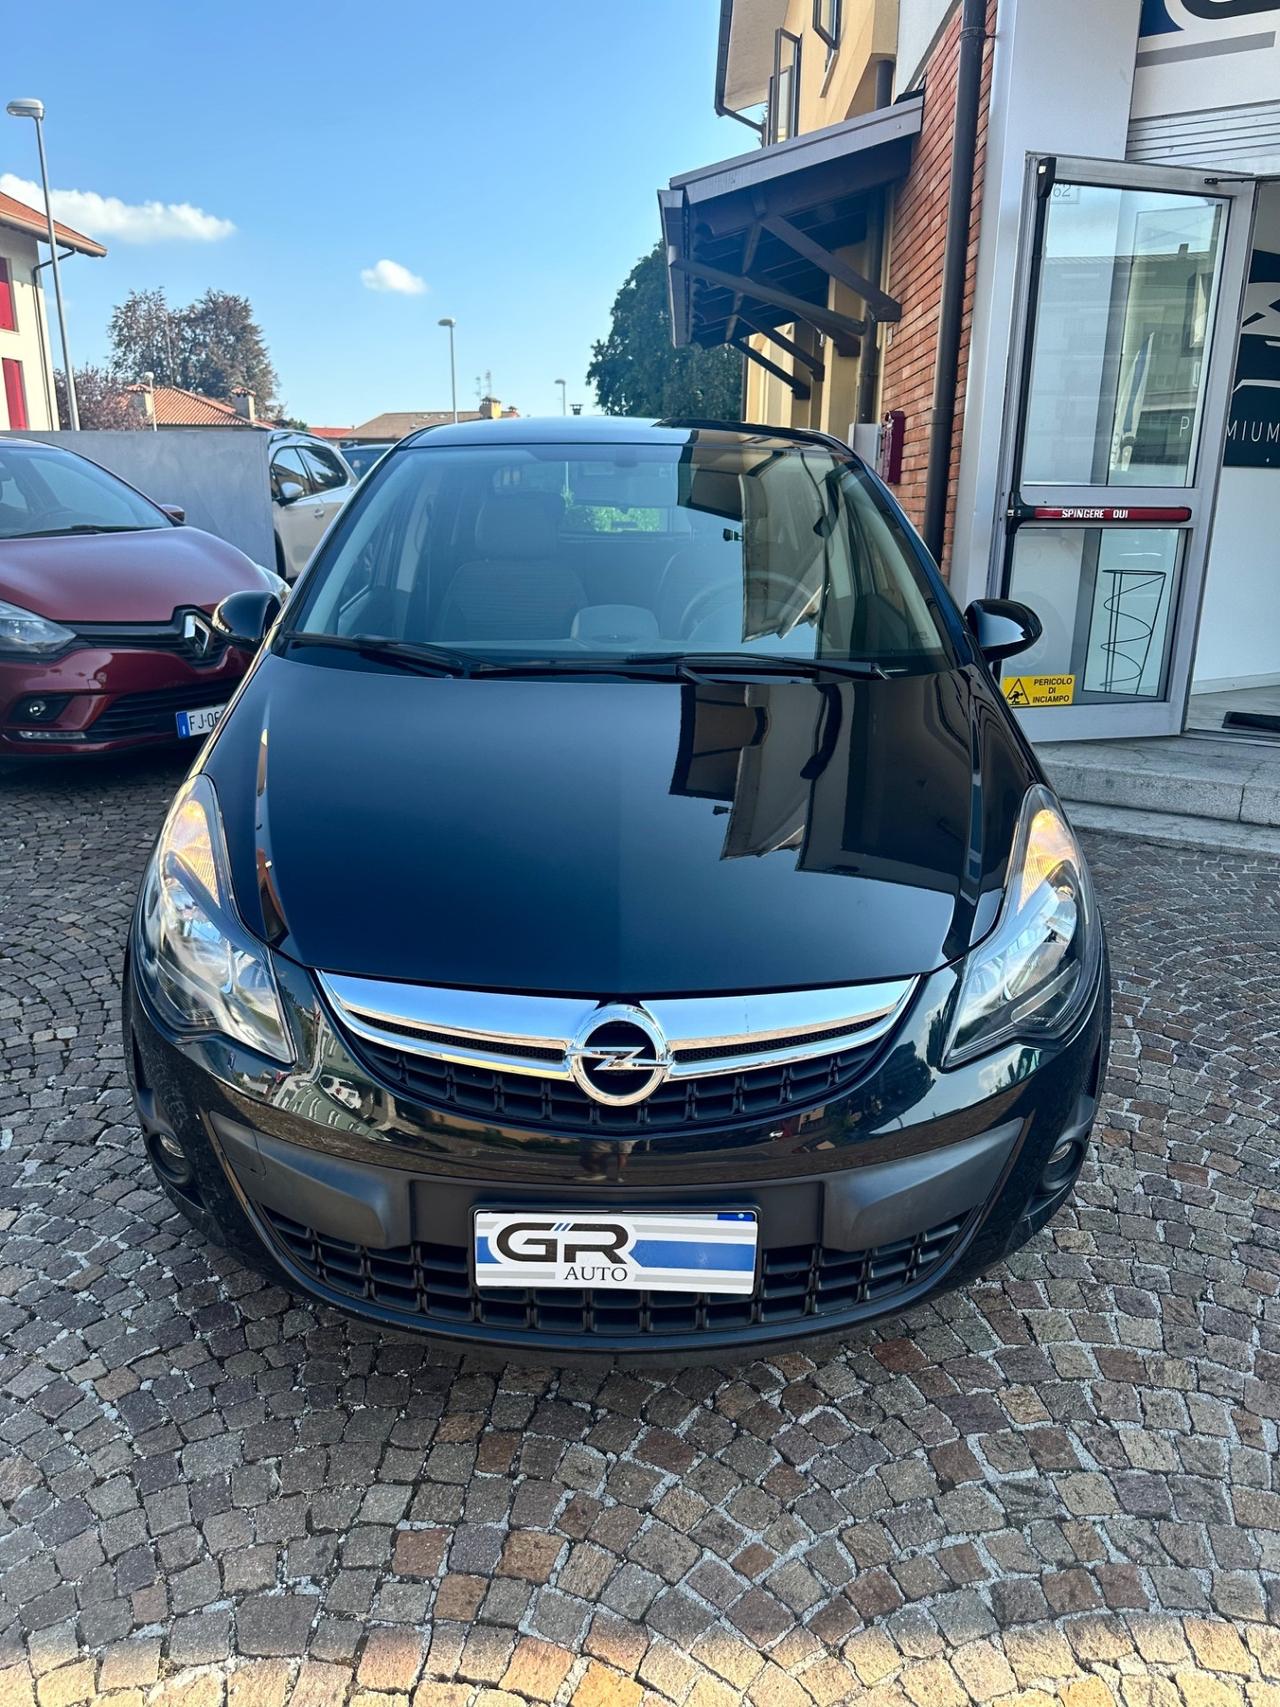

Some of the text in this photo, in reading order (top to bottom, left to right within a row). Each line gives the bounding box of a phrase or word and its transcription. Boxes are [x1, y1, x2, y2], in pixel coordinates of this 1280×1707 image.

[1061, 508, 1105, 519] SPINGERE
[1033, 677, 1073, 686] PERICOLO
[1048, 686, 1056, 694] DI
[1032, 694, 1070, 704] INCIAMPO
[496, 1221, 629, 1265] GR
[564, 1266, 629, 1282] AUTO
